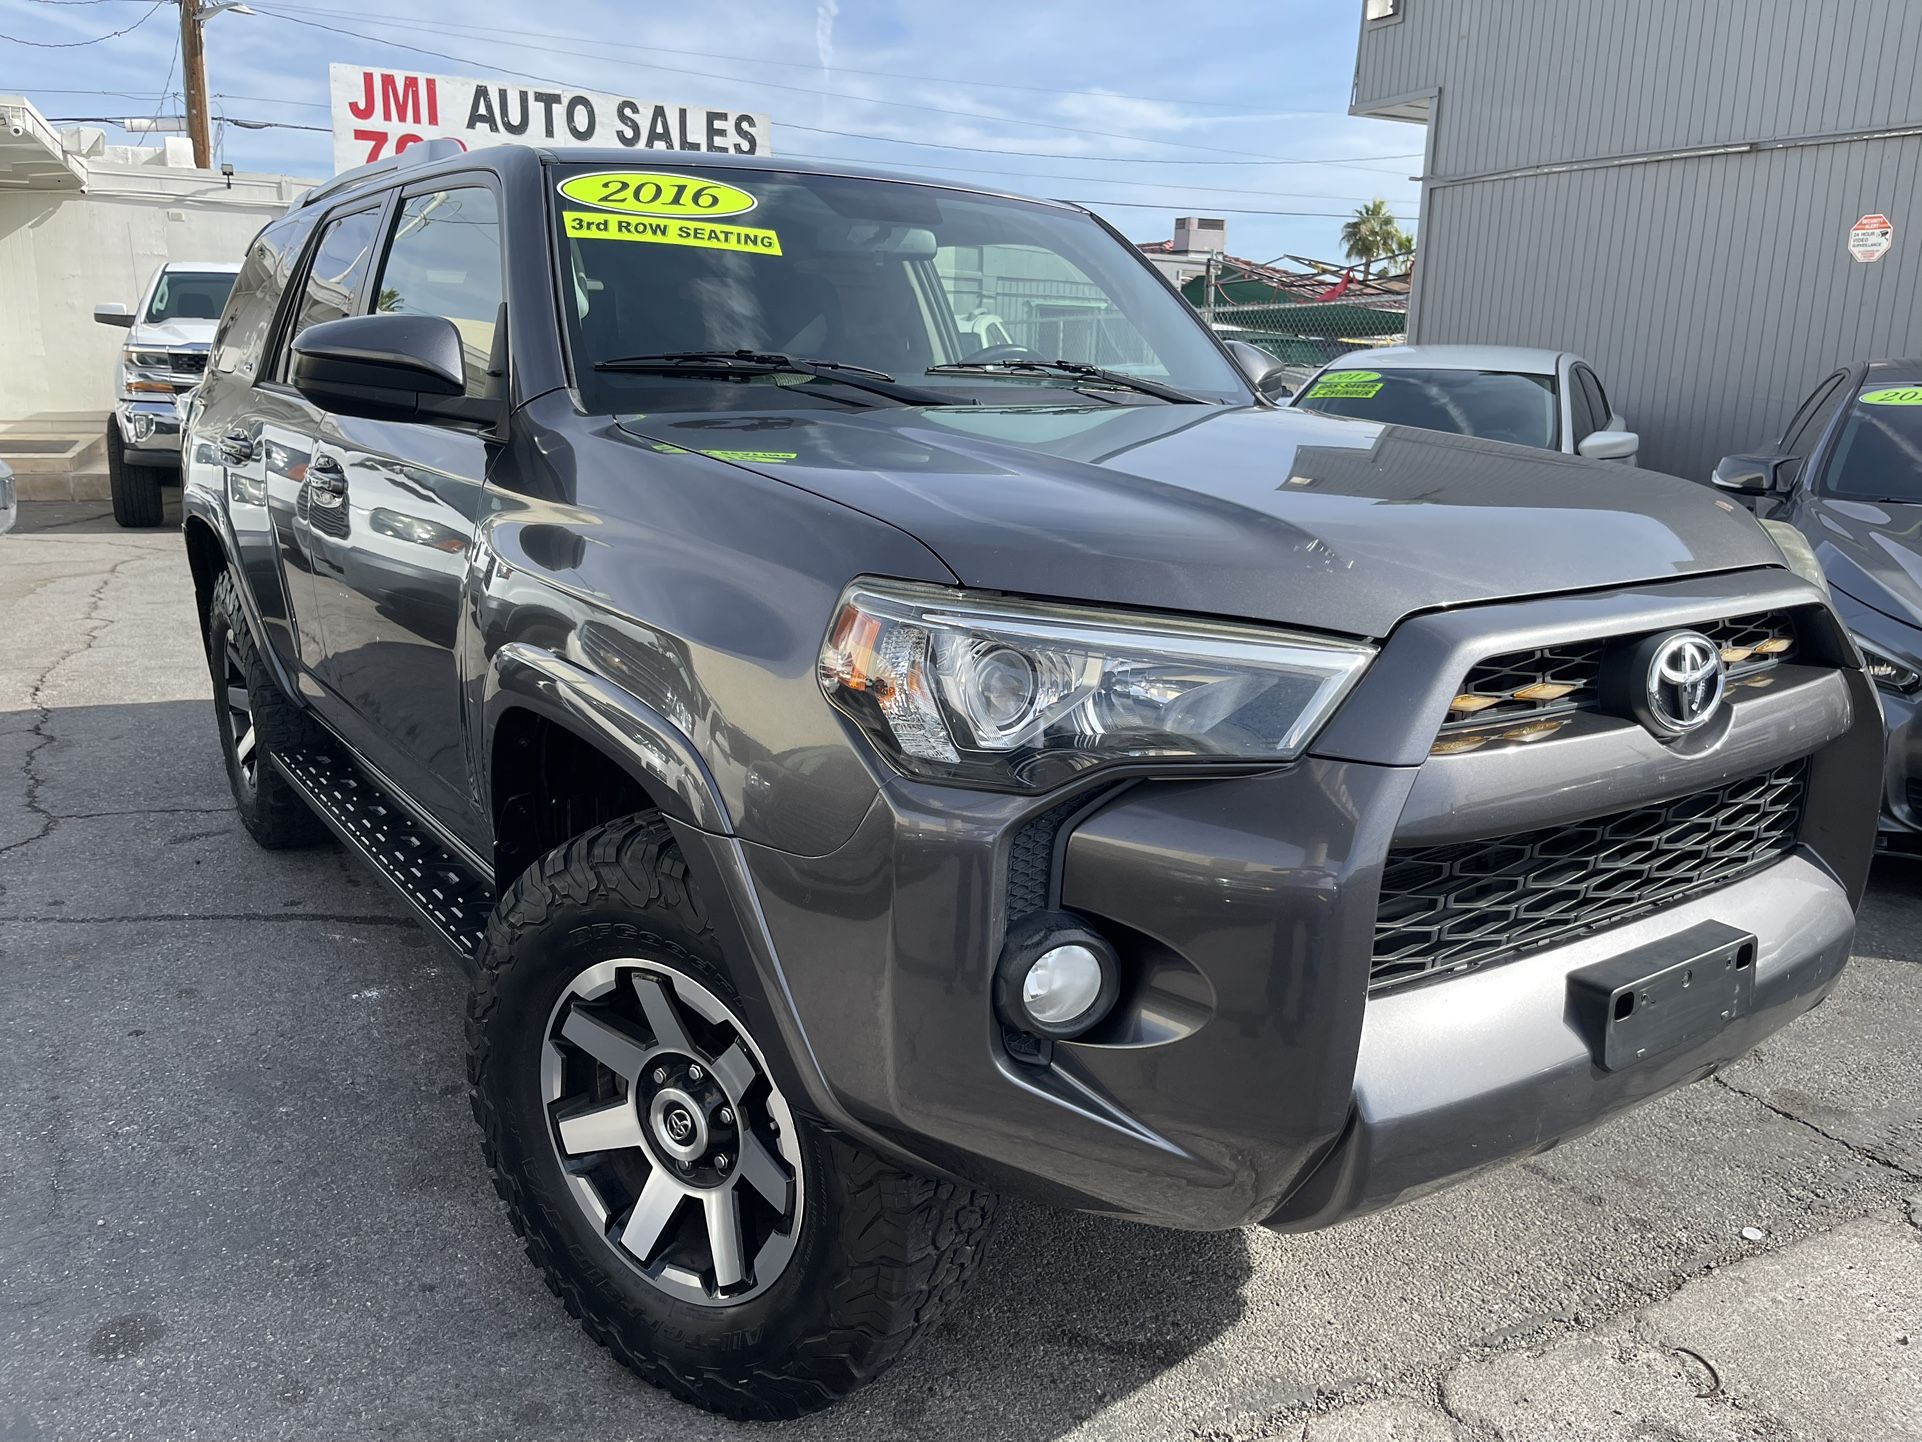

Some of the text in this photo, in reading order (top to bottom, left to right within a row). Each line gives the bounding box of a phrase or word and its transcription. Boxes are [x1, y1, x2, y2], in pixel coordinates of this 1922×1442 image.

[348, 72, 757, 155] JMI AUTO SALES
[597, 180, 721, 209] 2016
[571, 217, 774, 248] 3rd ROW SEATING
[1877, 391, 1922, 401] 20
